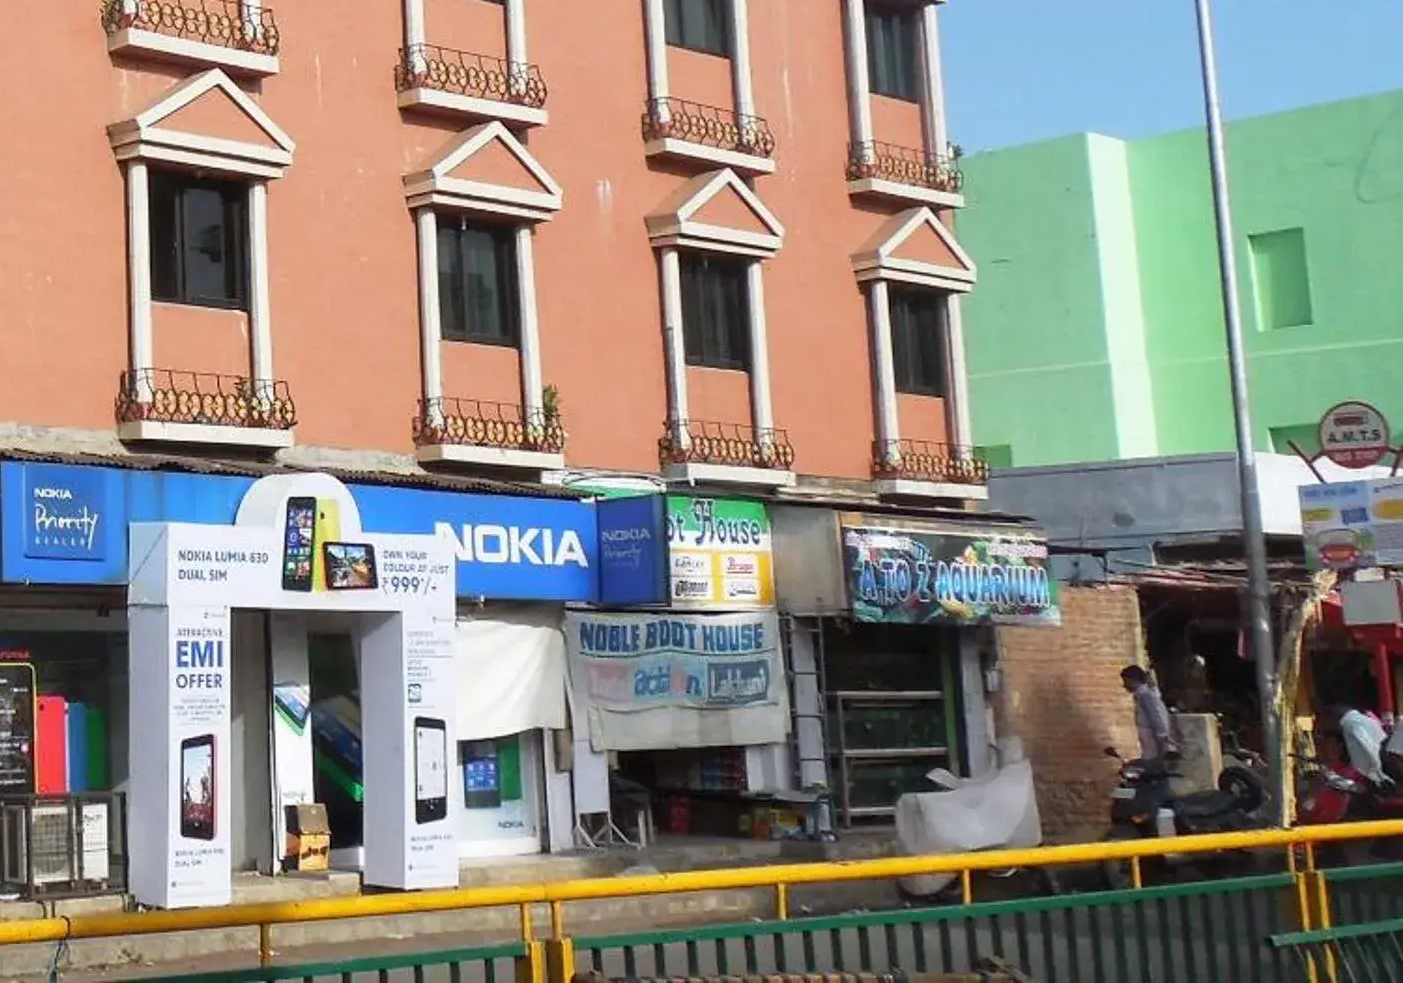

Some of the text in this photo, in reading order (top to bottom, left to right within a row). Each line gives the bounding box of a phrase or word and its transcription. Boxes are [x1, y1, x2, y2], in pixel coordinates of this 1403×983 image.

[34, 487, 72, 499] NOKIA
[35, 501, 98, 550] Priority
[690, 499, 761, 546] House
[602, 527, 651, 542] NOKIA
[434, 521, 589, 568] NOKIA
[178, 550, 212, 563] NOKIA
[215, 551, 247, 563] LUMIA
[178, 569, 228, 582] DUAL SIM
[429, 564, 450, 575] JUST
[935, 559, 1051, 607] AQUARIUM
[579, 619, 764, 653] NOBLE BOOT HOUSE
[176, 640, 224, 668] EMI
[176, 673, 223, 689] OFFER
[498, 820, 525, 829] NOKIA
